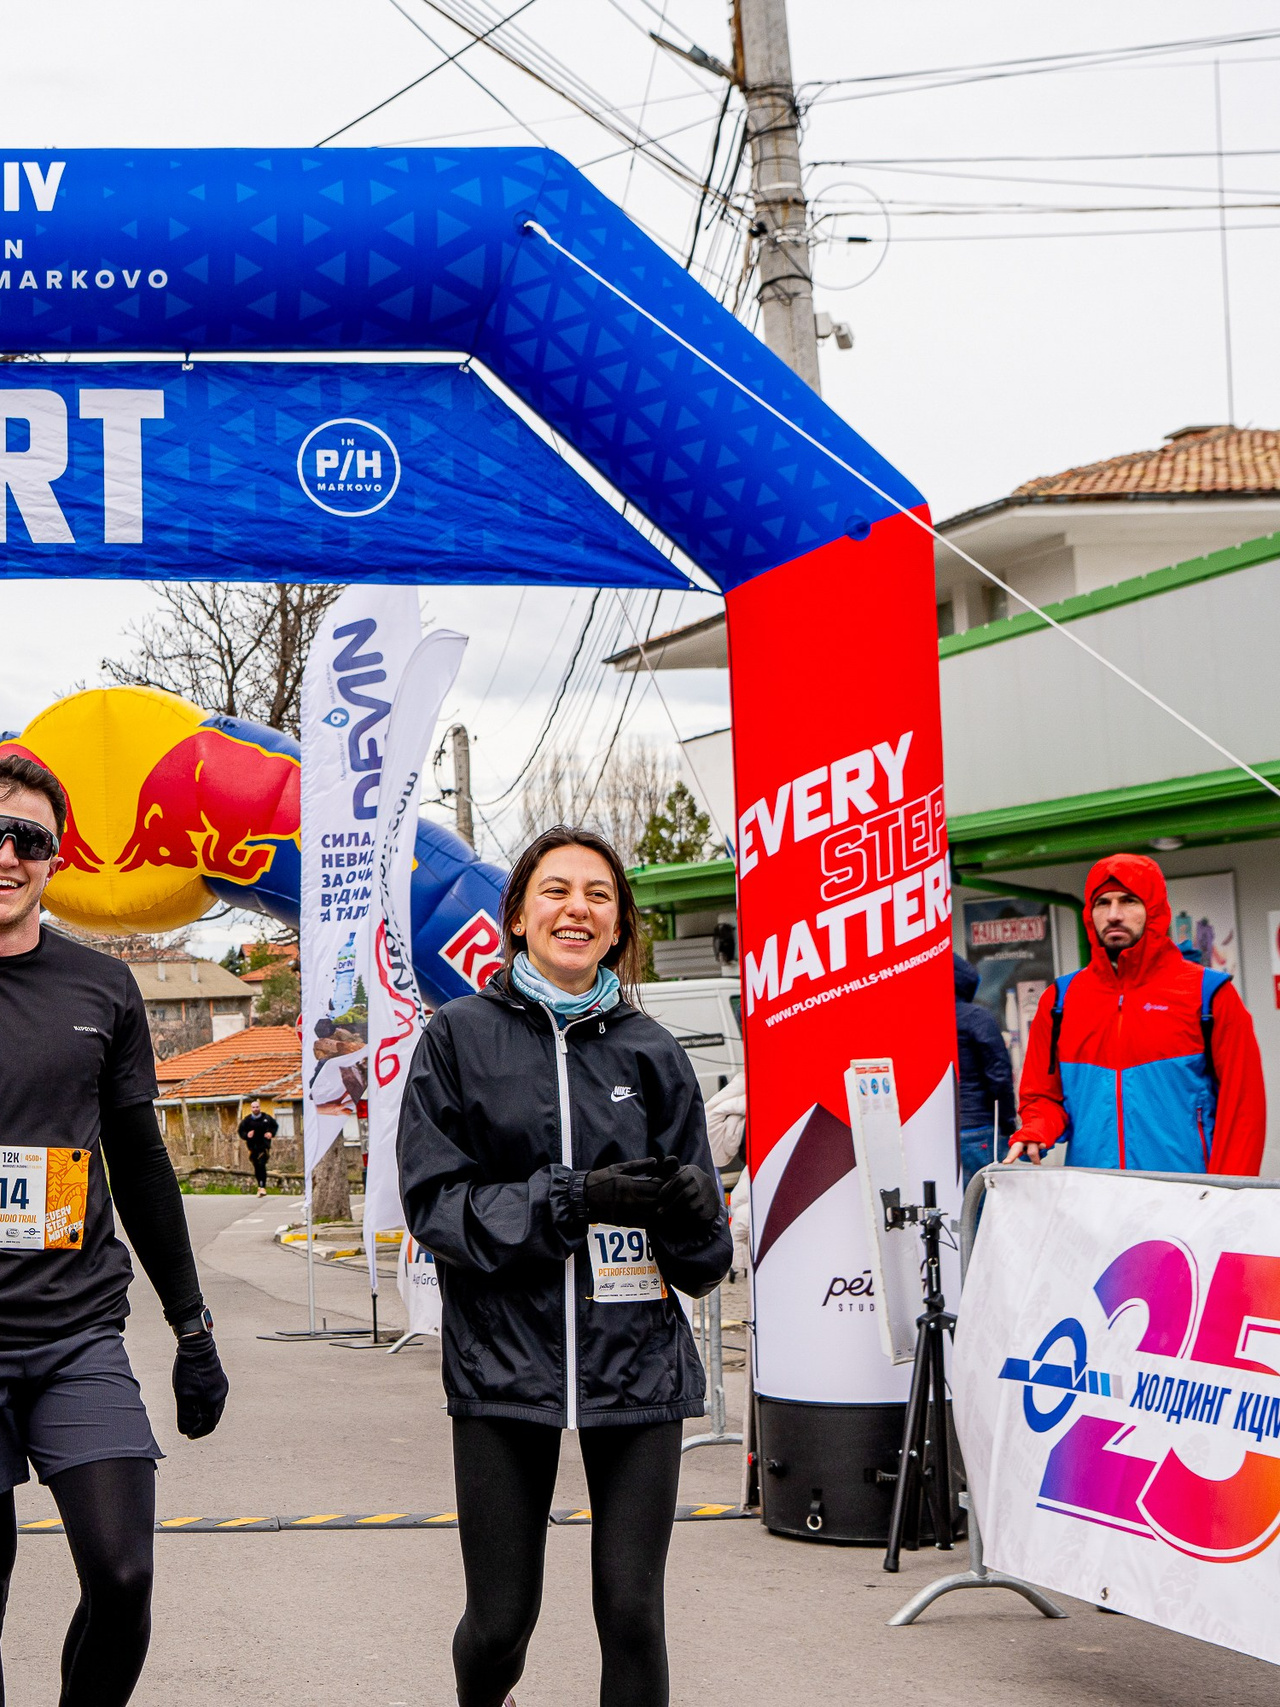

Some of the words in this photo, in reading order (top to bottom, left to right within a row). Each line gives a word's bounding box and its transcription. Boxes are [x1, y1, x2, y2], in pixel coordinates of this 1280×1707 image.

[341, 438, 355, 446] IN
[316, 449, 382, 481] P/H
[317, 483, 382, 492] MARKOVO
[738, 730, 914, 880] EVERY
[321, 832, 375, 848] СИЛА,
[820, 783, 945, 902] STEP
[321, 873, 344, 888] ЗА
[613, 1085, 631, 1096] NIKE
[2, 1151, 20, 1163] 12K
[18, 1214, 37, 1224] TRAIL
[1130, 1372, 1232, 1425] ХОЛДИНГ
